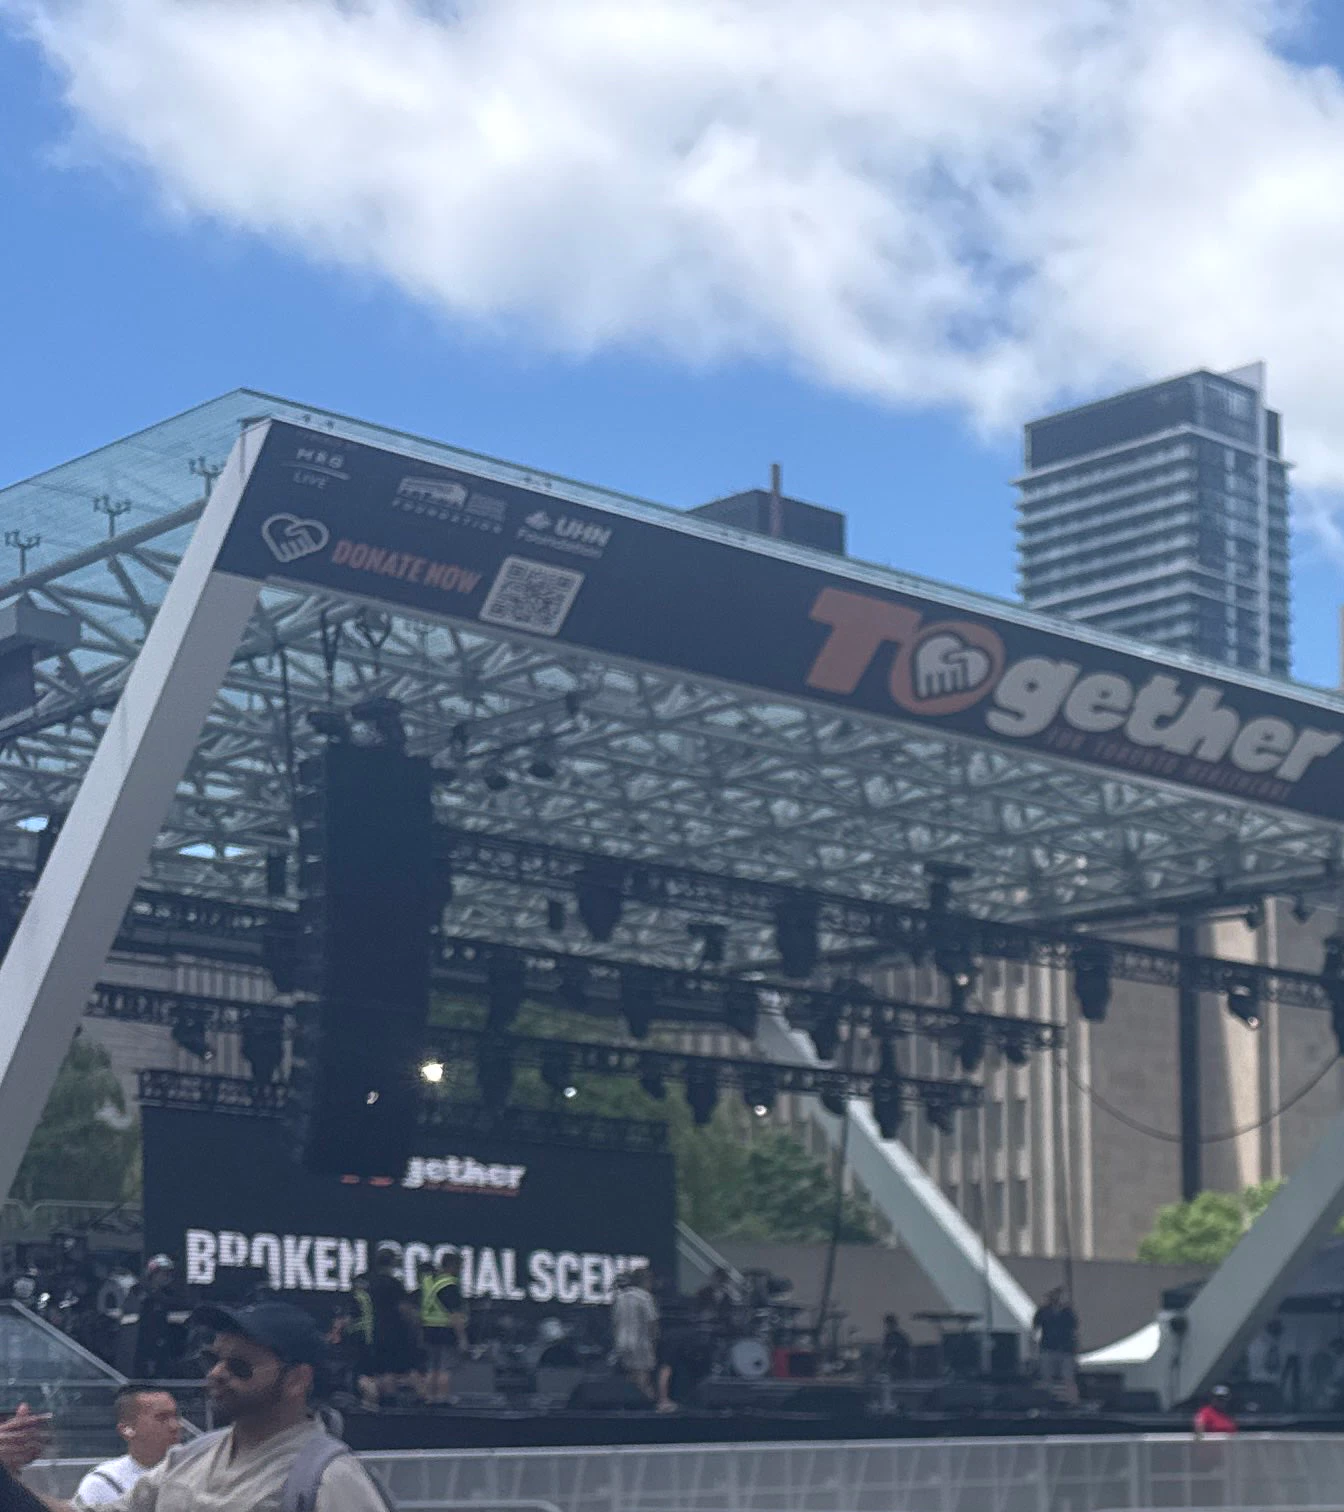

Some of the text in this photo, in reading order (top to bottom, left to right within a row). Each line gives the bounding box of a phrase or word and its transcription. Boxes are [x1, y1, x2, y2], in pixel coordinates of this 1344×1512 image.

[555, 514, 613, 547] UHN
[331, 539, 484, 596] DONATE NOW
